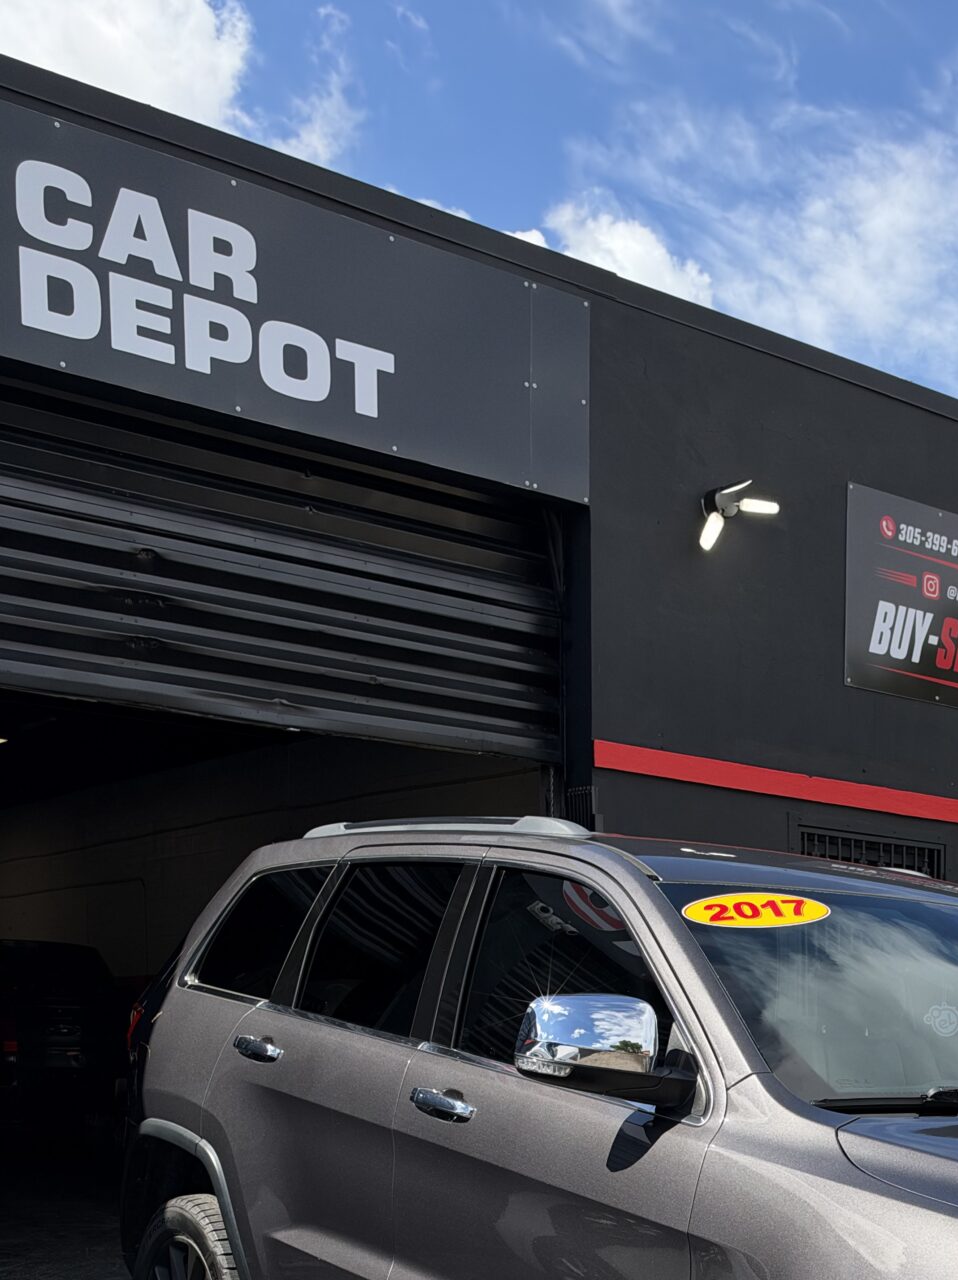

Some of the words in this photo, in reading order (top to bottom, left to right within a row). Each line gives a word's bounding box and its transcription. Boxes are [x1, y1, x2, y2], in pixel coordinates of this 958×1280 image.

[15, 160, 257, 303] CAR
[19, 246, 395, 418] DEPOT
[704, 899, 807, 922] 2017
